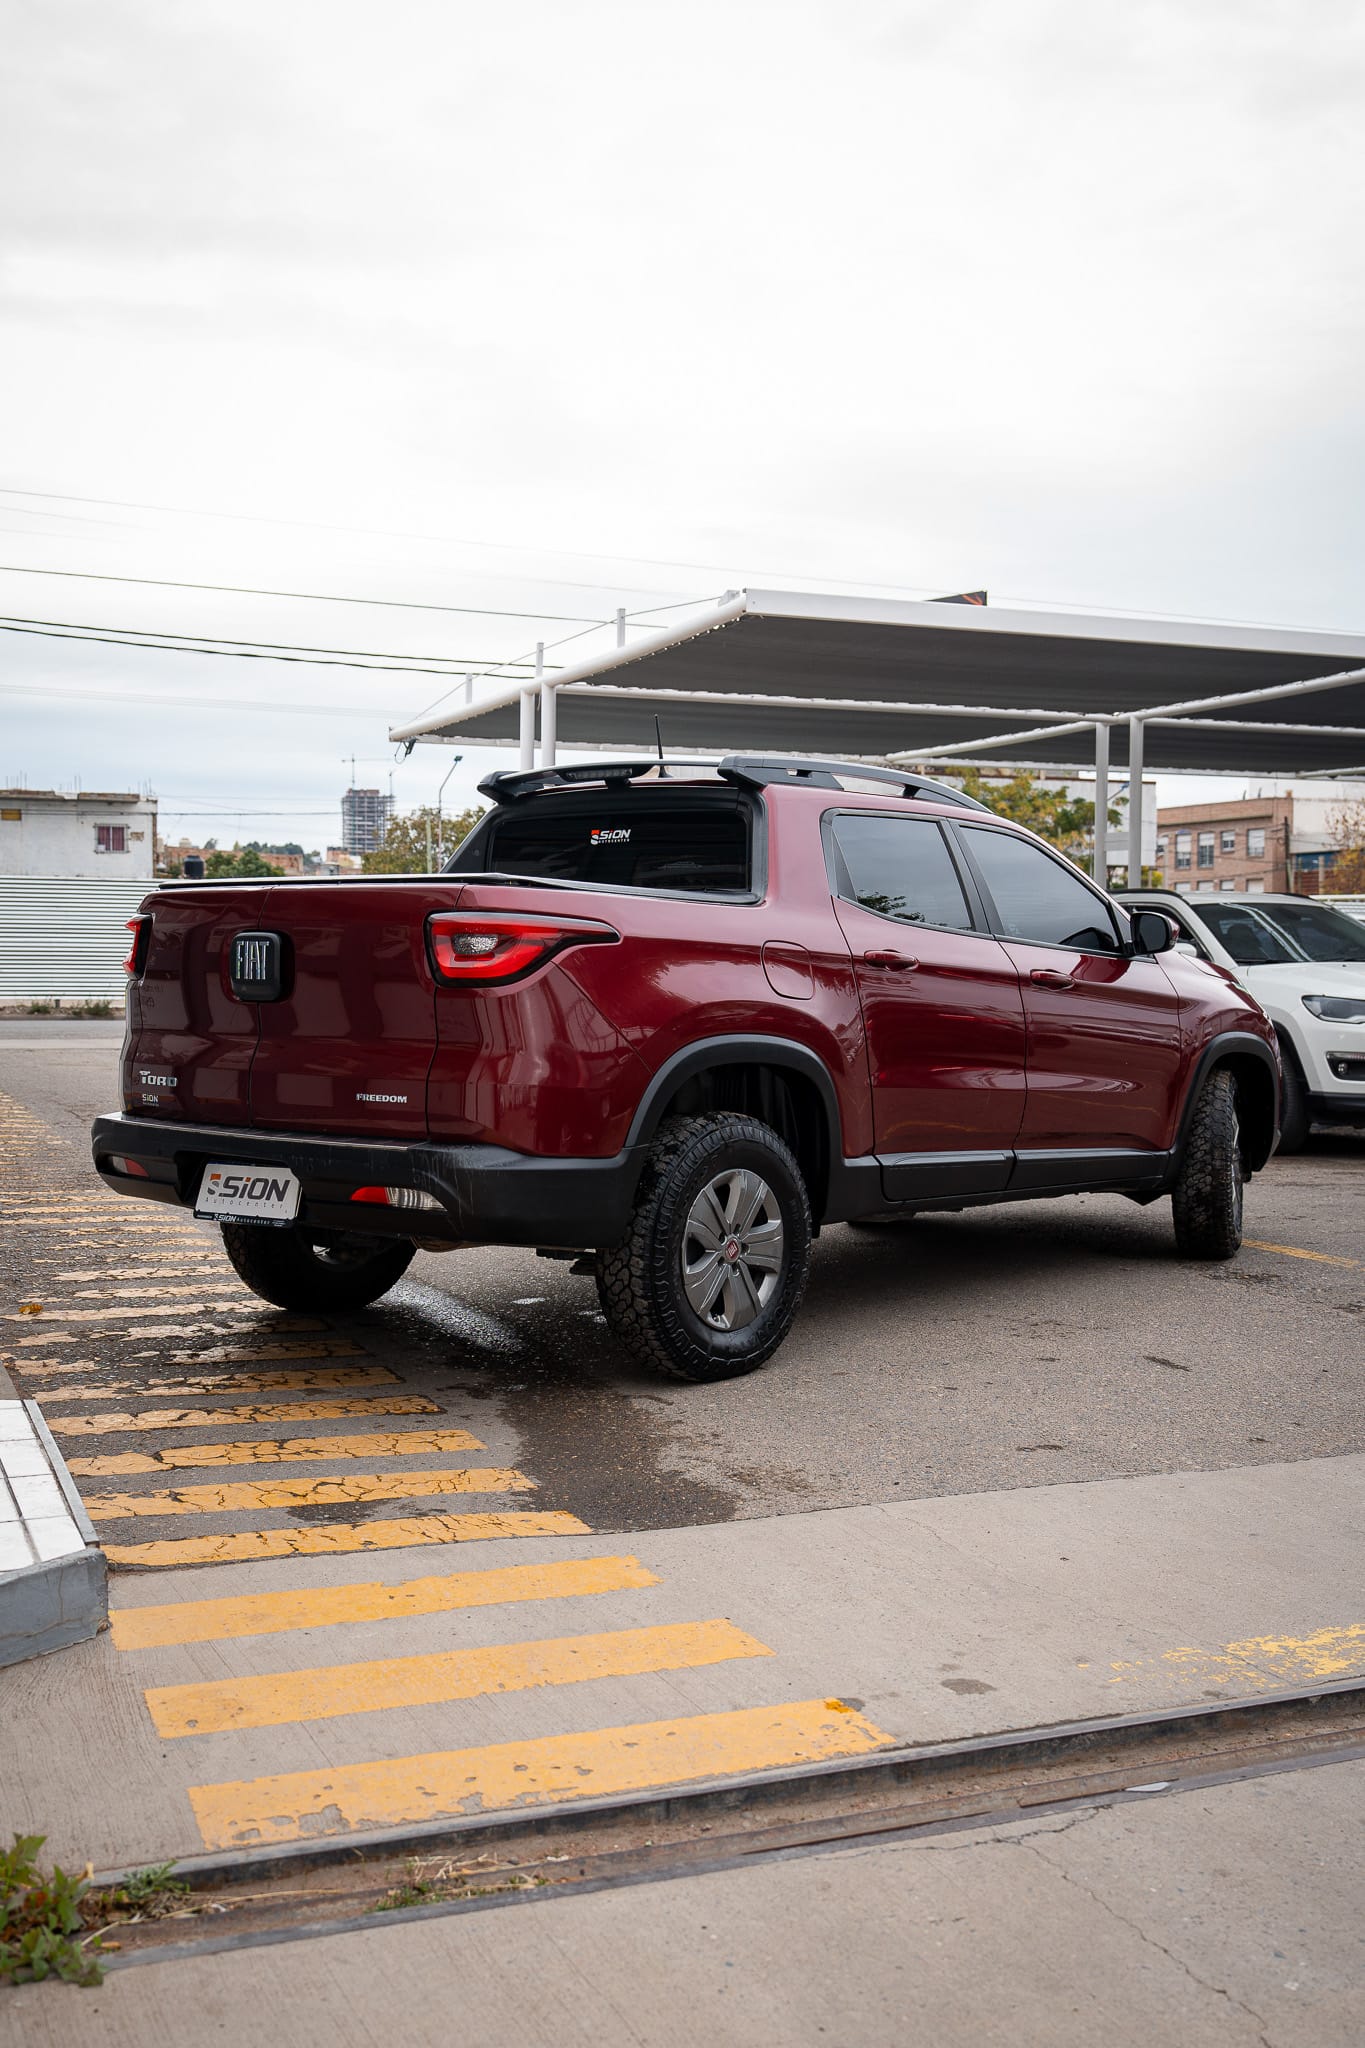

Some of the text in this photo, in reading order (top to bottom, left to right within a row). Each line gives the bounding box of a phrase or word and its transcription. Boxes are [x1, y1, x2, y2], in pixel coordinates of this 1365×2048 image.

[236, 941, 270, 979] FIAT
[356, 1093, 407, 1103] FREEDOM
[205, 1197, 283, 1208] Autocenter
